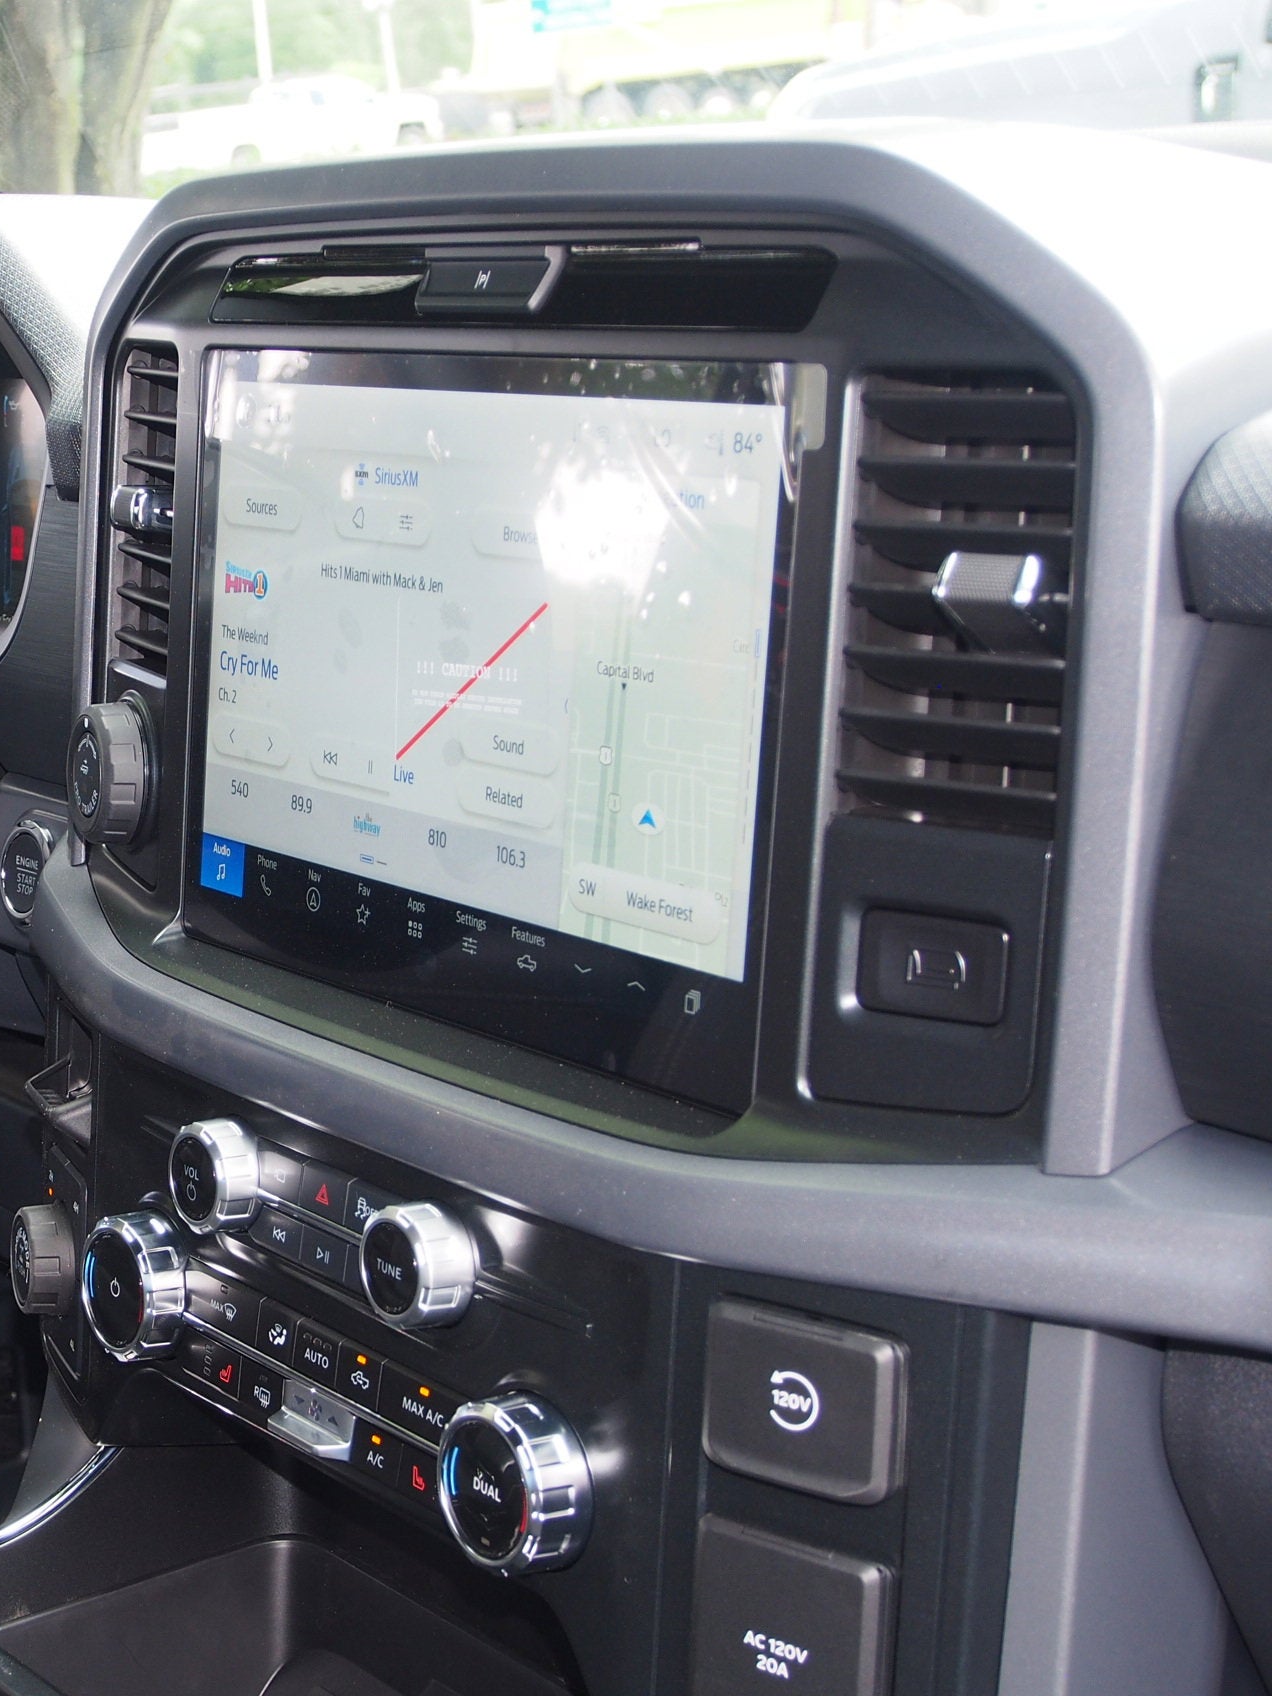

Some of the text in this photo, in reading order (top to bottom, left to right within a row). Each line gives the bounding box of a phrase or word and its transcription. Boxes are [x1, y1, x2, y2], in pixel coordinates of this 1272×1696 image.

[375, 467, 420, 487] SiriusXM
[245, 498, 278, 517] Sources
[320, 562, 444, 594] Hits 1 Miami with Mack & Jen
[222, 624, 269, 647] The Weeknd
[220, 651, 279, 681] Cry For Me
[441, 662, 491, 680] CAUTION
[596, 660, 655, 684] Capital Blvd
[218, 687, 237, 704] Ch. 2
[492, 735, 525, 755] Sound
[393, 765, 415, 785] Live
[231, 779, 249, 798] 540
[485, 786, 524, 809] Related
[291, 794, 313, 814] 89.9
[428, 828, 447, 849] 810
[213, 840, 231, 858] Audio
[496, 844, 526, 869] 106.3
[15, 854, 39, 870] ENGINE
[257, 853, 278, 871] Phone
[16, 872, 37, 886] START
[308, 868, 322, 883] Nav
[16, 883, 34, 896] STOP
[358, 882, 371, 898] Fav
[578, 878, 597, 898] SW
[407, 896, 426, 914] Apps
[626, 890, 657, 913] Wake
[658, 899, 694, 923] Forest
[455, 910, 487, 932] Settings
[511, 926, 546, 948] Features
[183, 1163, 200, 1182] VOL
[376, 1257, 403, 1281] TUNE
[210, 1298, 225, 1314] MAX
[304, 1347, 330, 1370] AUTO
[771, 1388, 812, 1413] 120V
[402, 1395, 445, 1429] MAX A/C
[366, 1449, 385, 1470] A/C
[472, 1475, 502, 1503] DUAL
[743, 1629, 809, 1665] AC 120V
[756, 1654, 789, 1680] 20A
